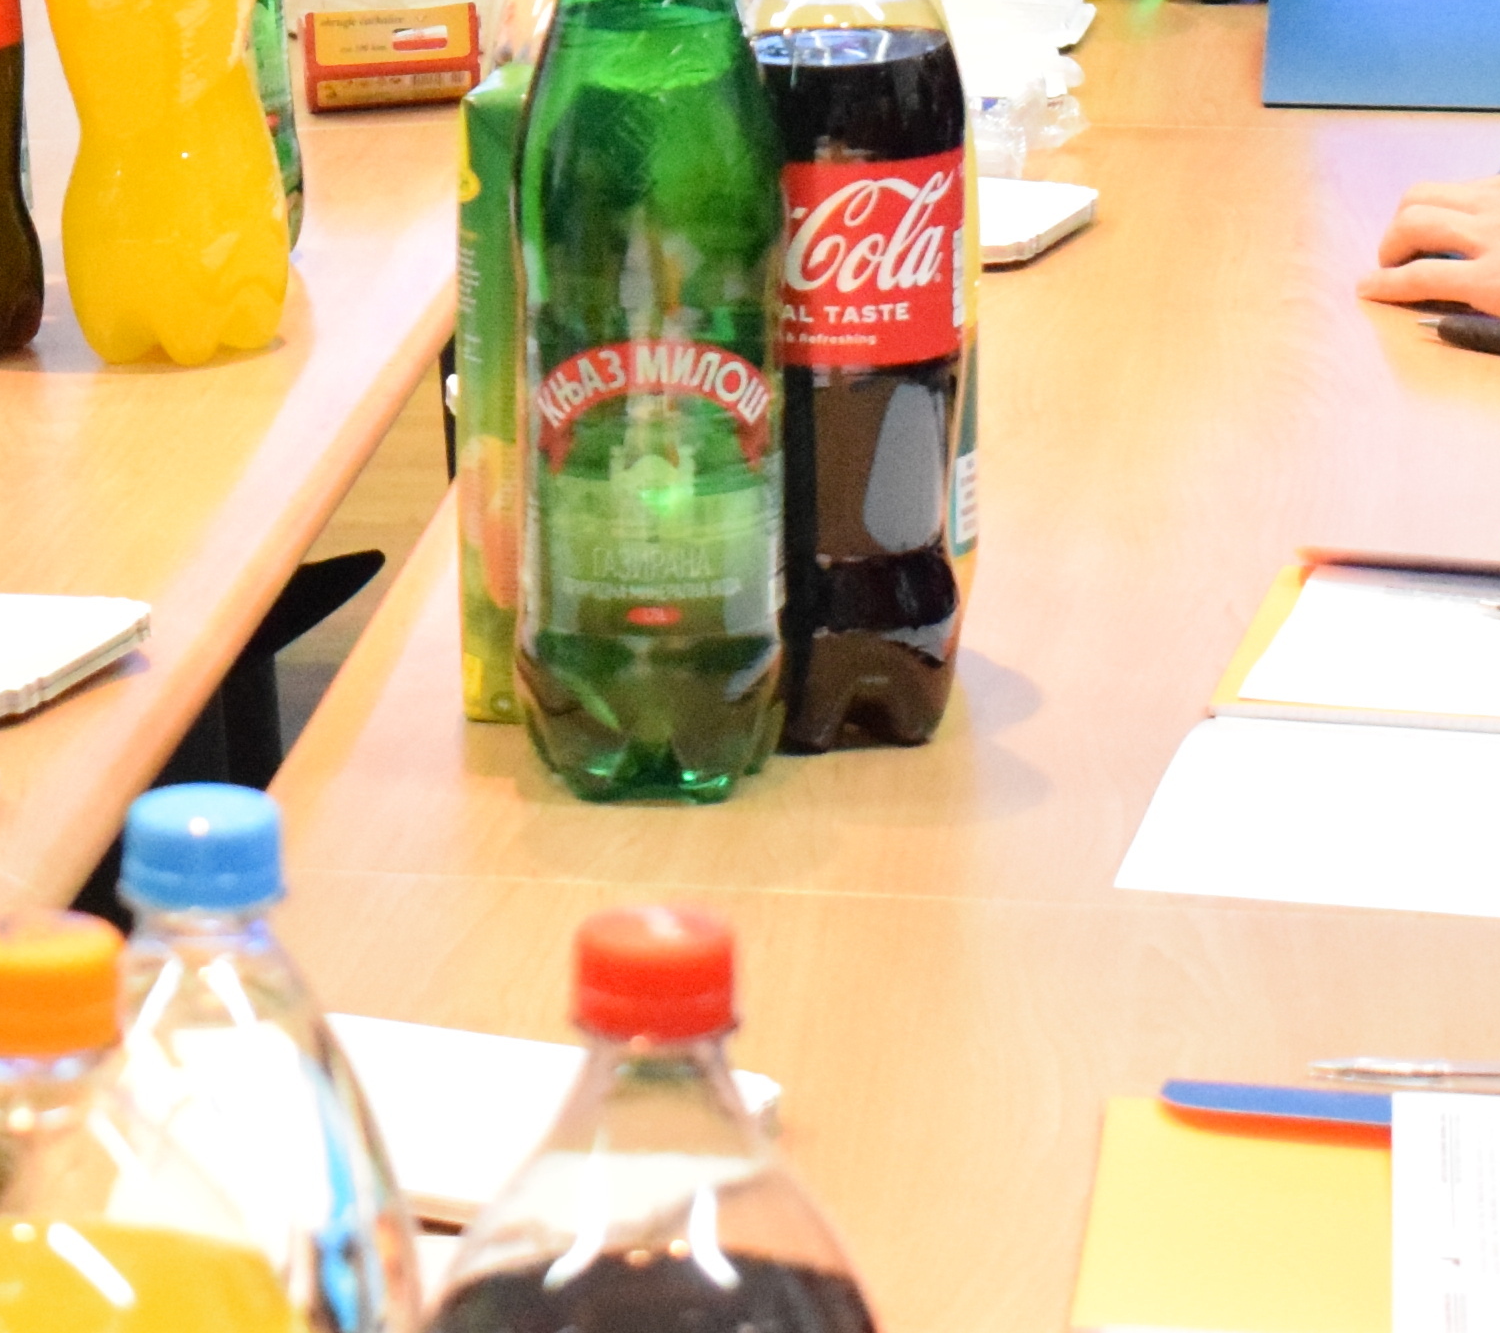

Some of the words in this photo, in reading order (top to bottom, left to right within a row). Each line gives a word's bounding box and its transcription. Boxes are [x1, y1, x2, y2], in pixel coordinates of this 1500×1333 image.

[822, 300, 911, 324] TASTE
[538, 348, 627, 427] КЊАЗ
[635, 343, 771, 428] МИЛОШ
